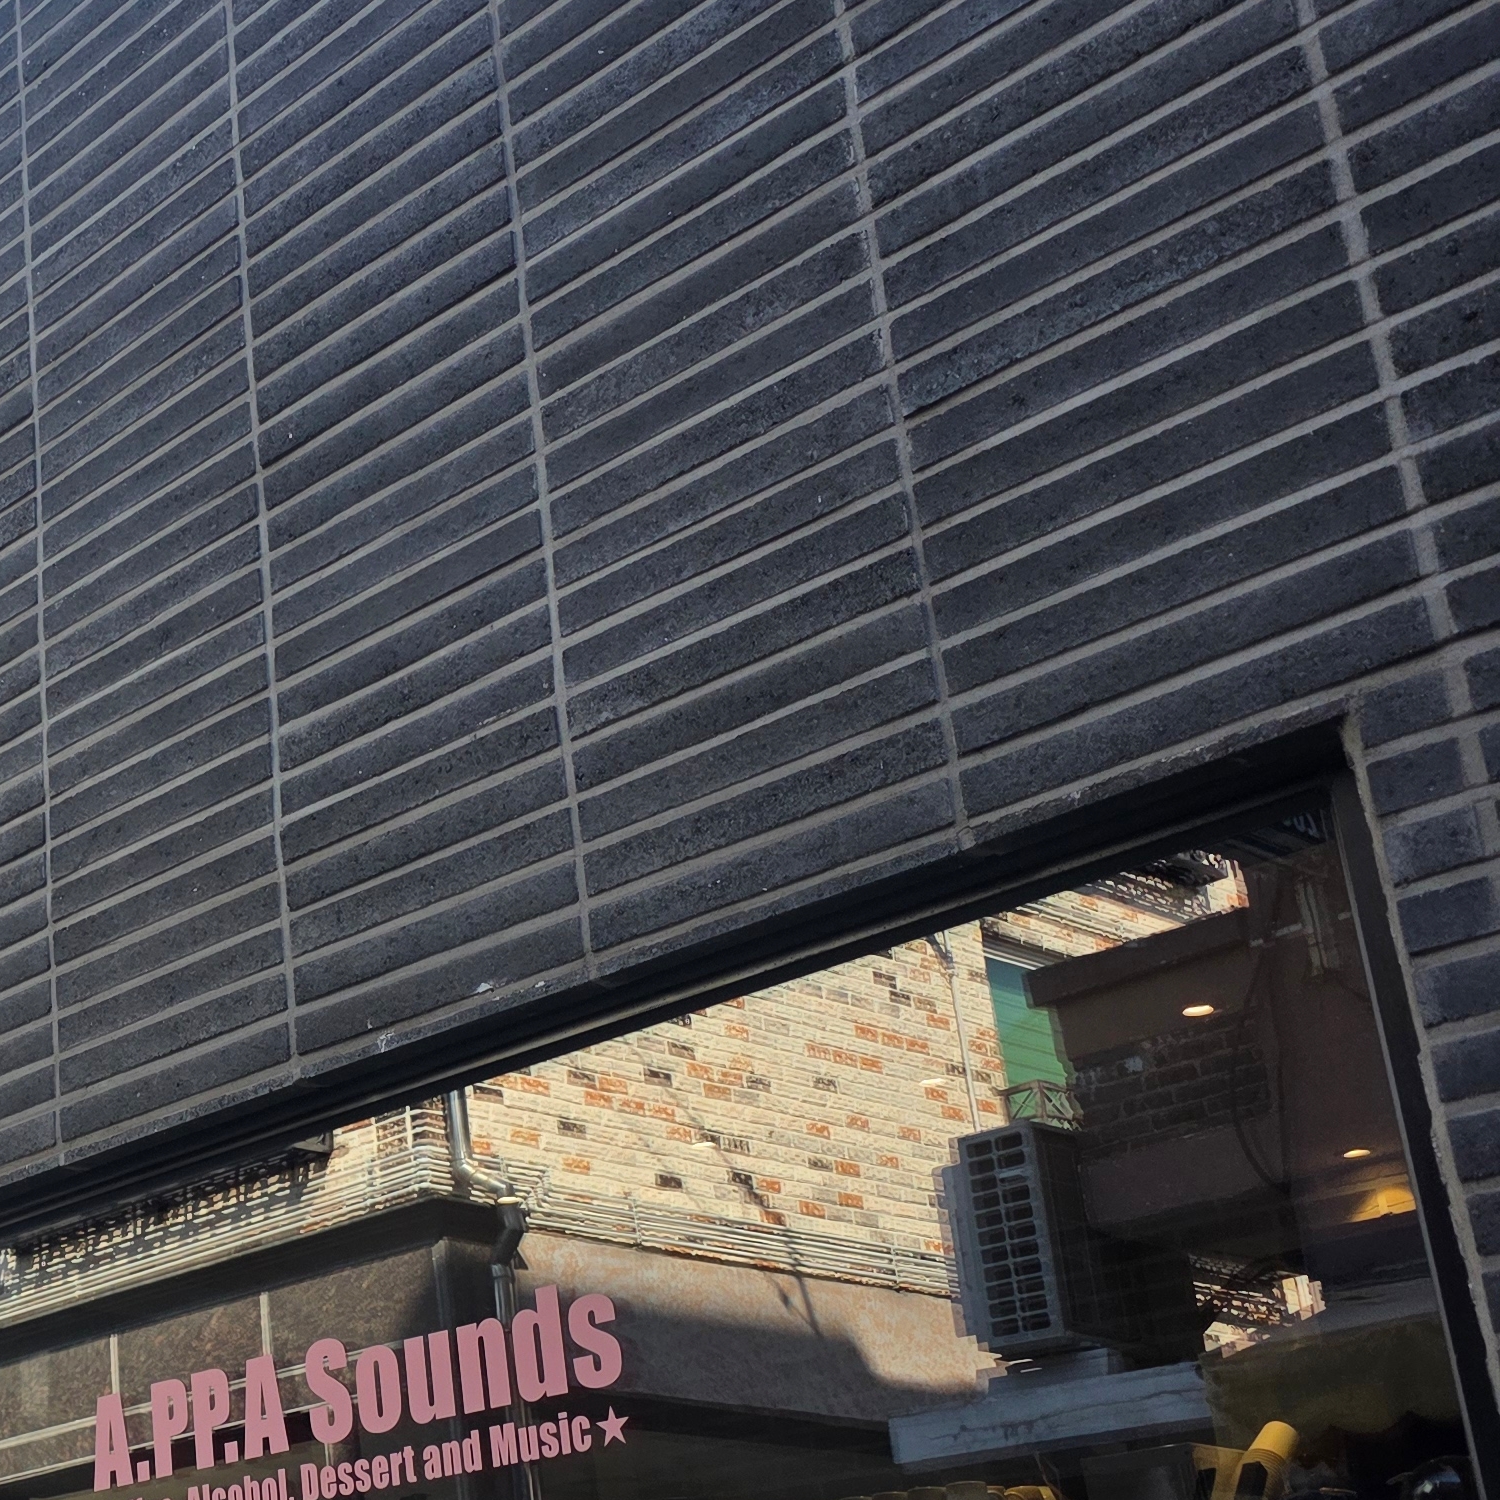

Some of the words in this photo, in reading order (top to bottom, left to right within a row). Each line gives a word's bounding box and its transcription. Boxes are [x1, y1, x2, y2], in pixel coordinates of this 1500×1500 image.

[93, 1354, 289, 1492] A.PP.A
[304, 1285, 624, 1445] Sounds
[423, 1430, 482, 1481] and
[489, 1411, 593, 1468] Music
